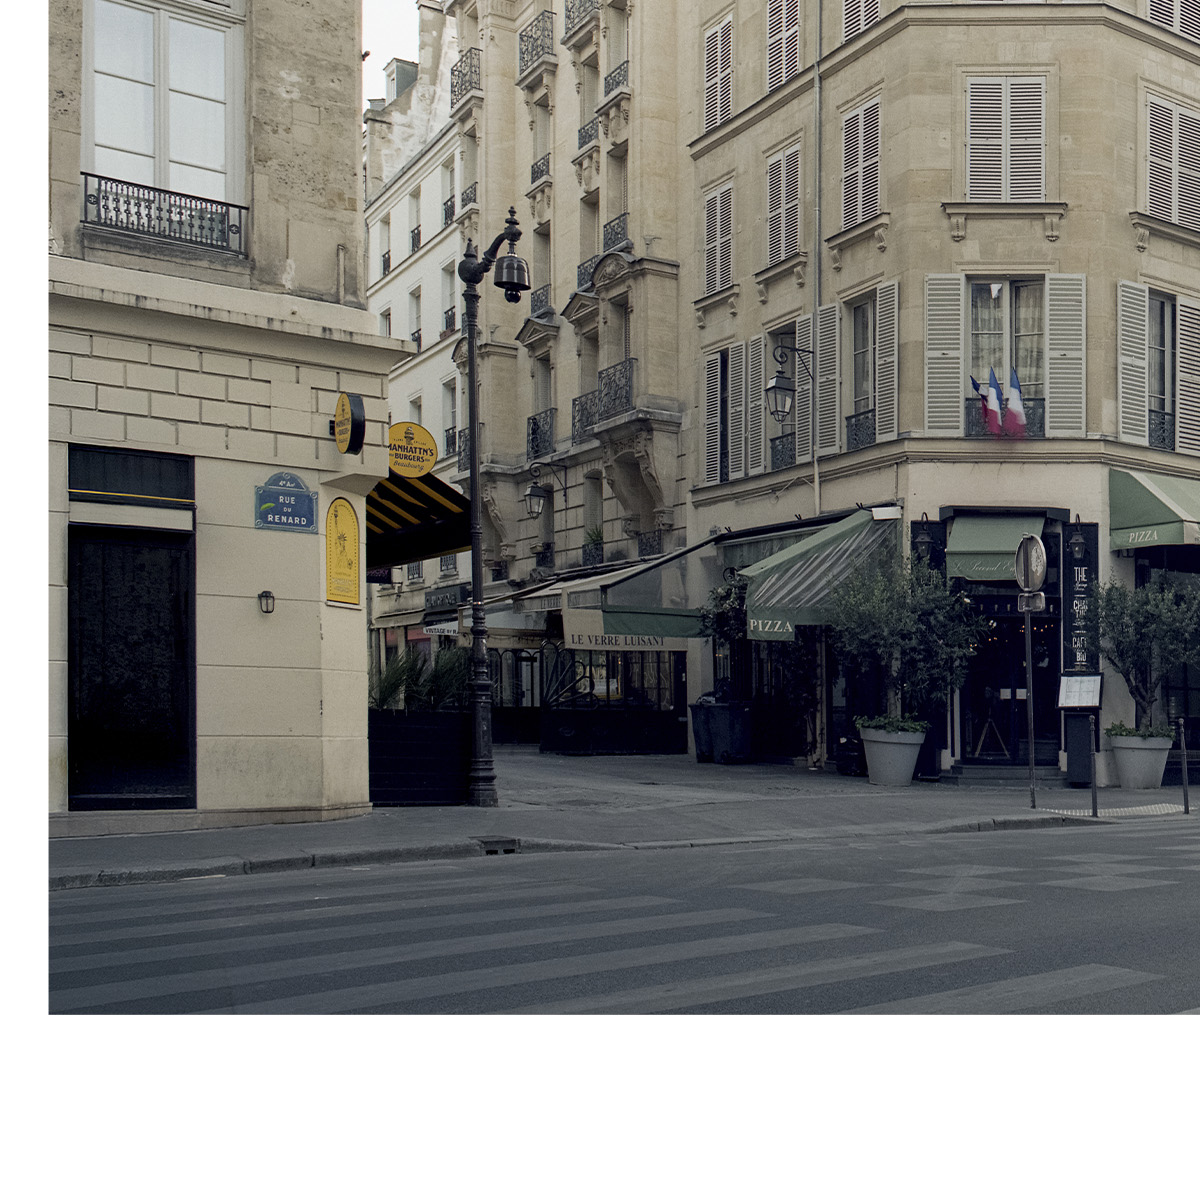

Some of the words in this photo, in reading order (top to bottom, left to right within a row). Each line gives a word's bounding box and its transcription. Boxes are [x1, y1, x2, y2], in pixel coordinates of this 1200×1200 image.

[394, 453, 425, 463] BURGERS
[279, 495, 296, 504] RUE
[267, 514, 307, 525] RENARD
[1128, 530, 1158, 543] PIZZA
[966, 560, 1002, 572] Second
[1073, 566, 1088, 582] THE
[750, 619, 793, 632] PIZZA
[571, 634, 584, 645] LE
[587, 634, 620, 646] VERRE
[624, 636, 665, 647] LUISANT
